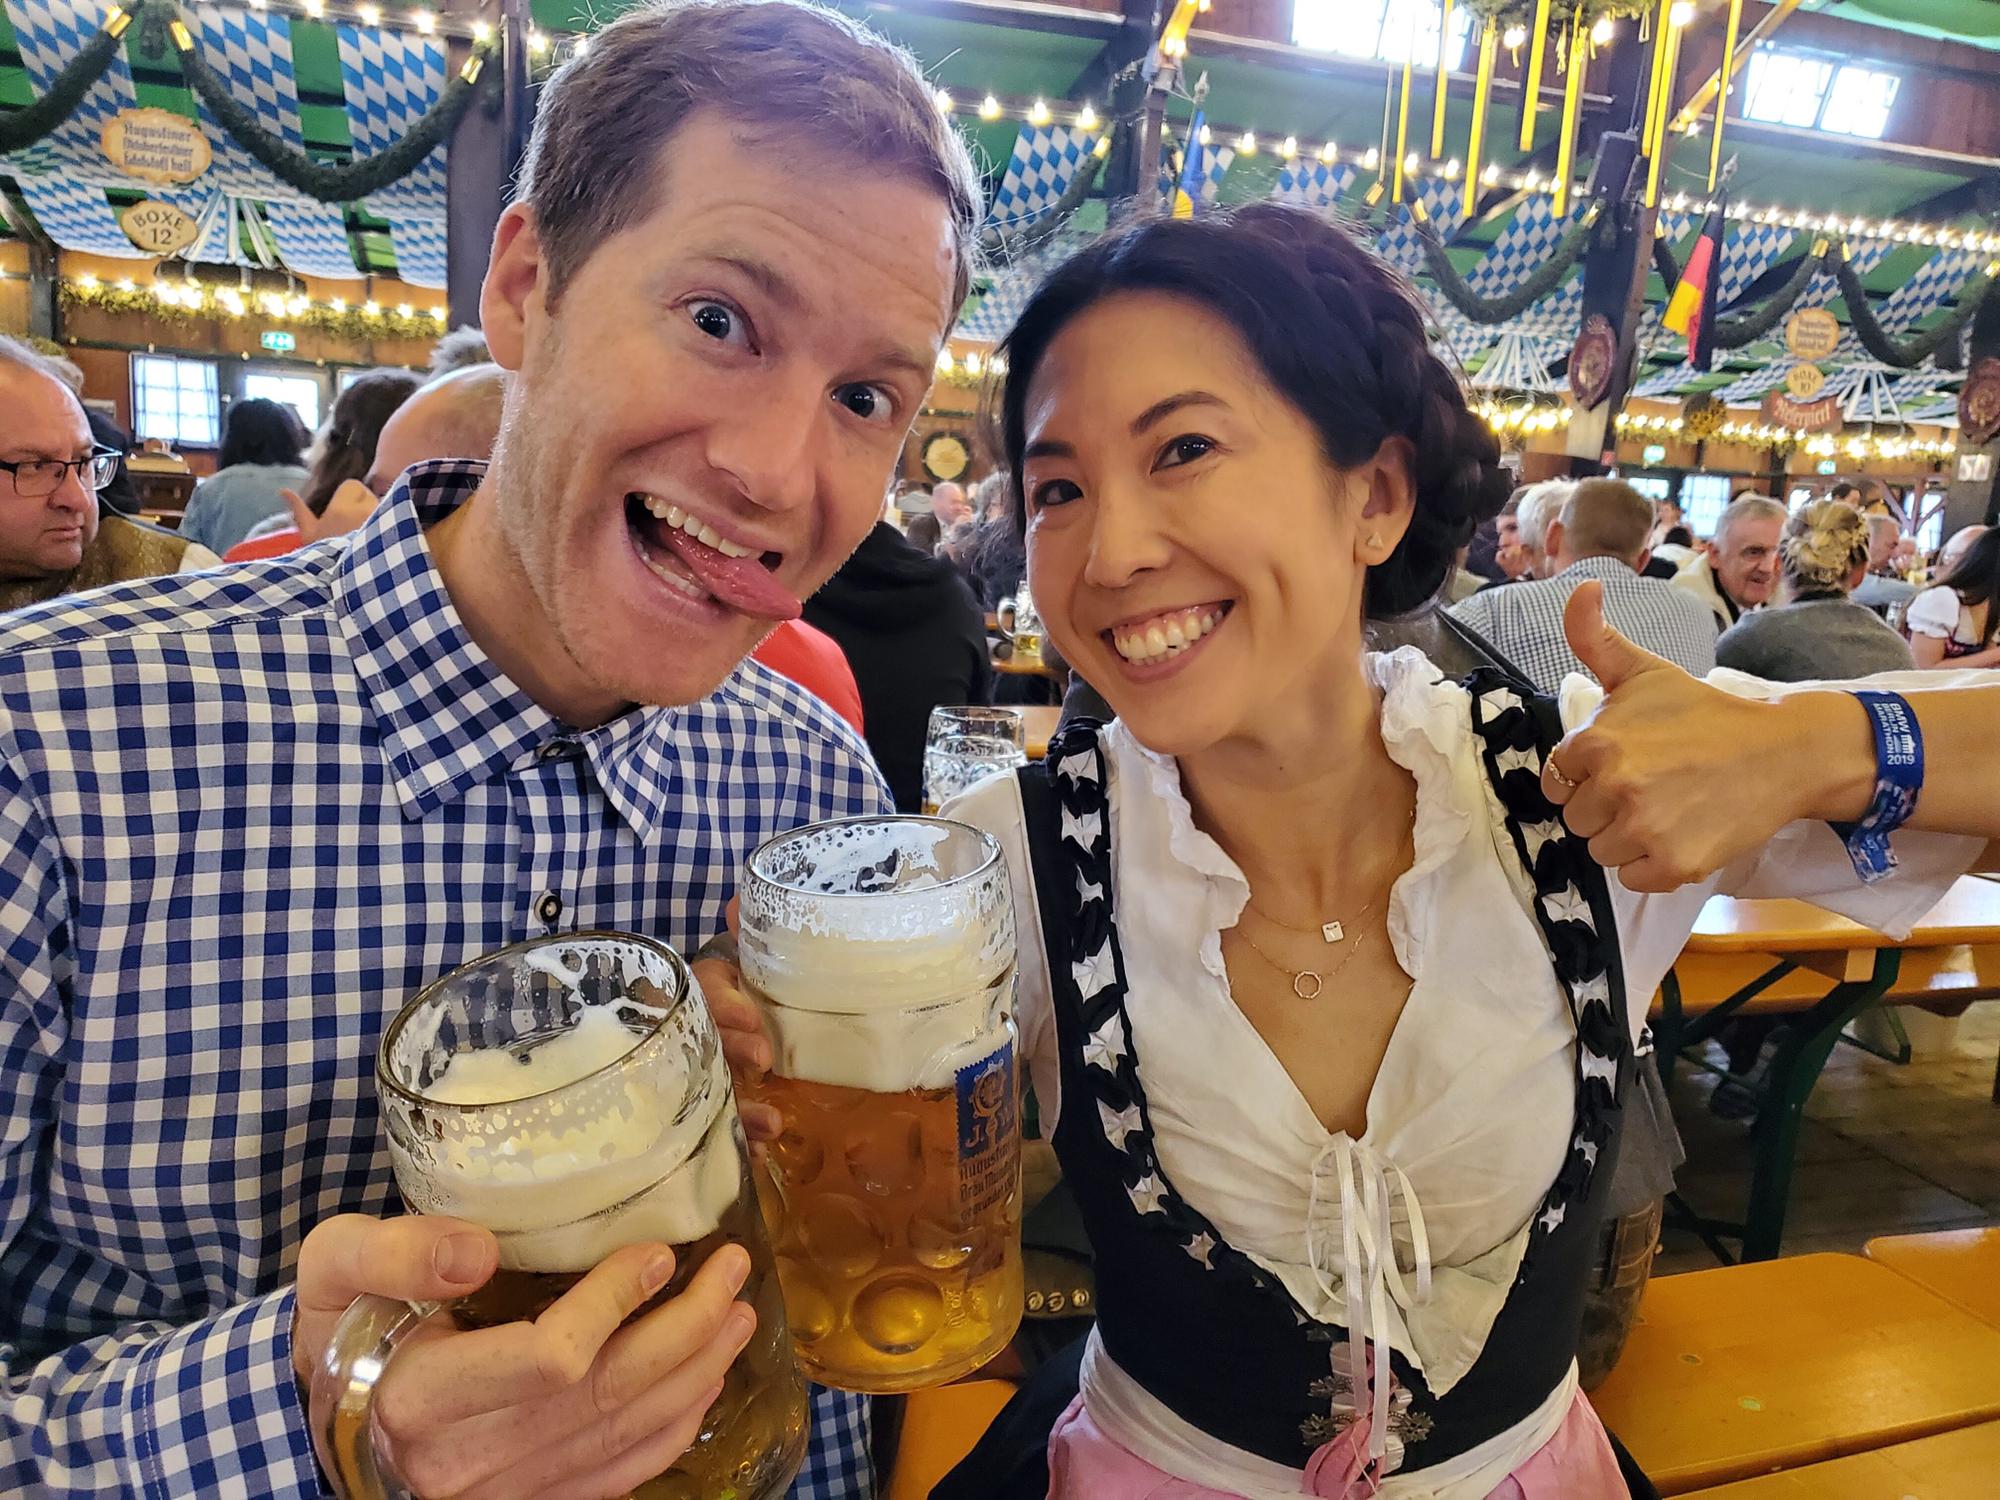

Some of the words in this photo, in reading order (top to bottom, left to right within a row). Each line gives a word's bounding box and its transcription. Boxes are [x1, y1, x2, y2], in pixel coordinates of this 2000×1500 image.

[132, 210, 185, 231] BOXE
[150, 228, 173, 245] 12
[1873, 703, 1895, 754] MARATHON
[1881, 703, 1900, 733] BERLIN
[1889, 703, 1911, 733] BMW
[1887, 754, 1916, 765] 2019
